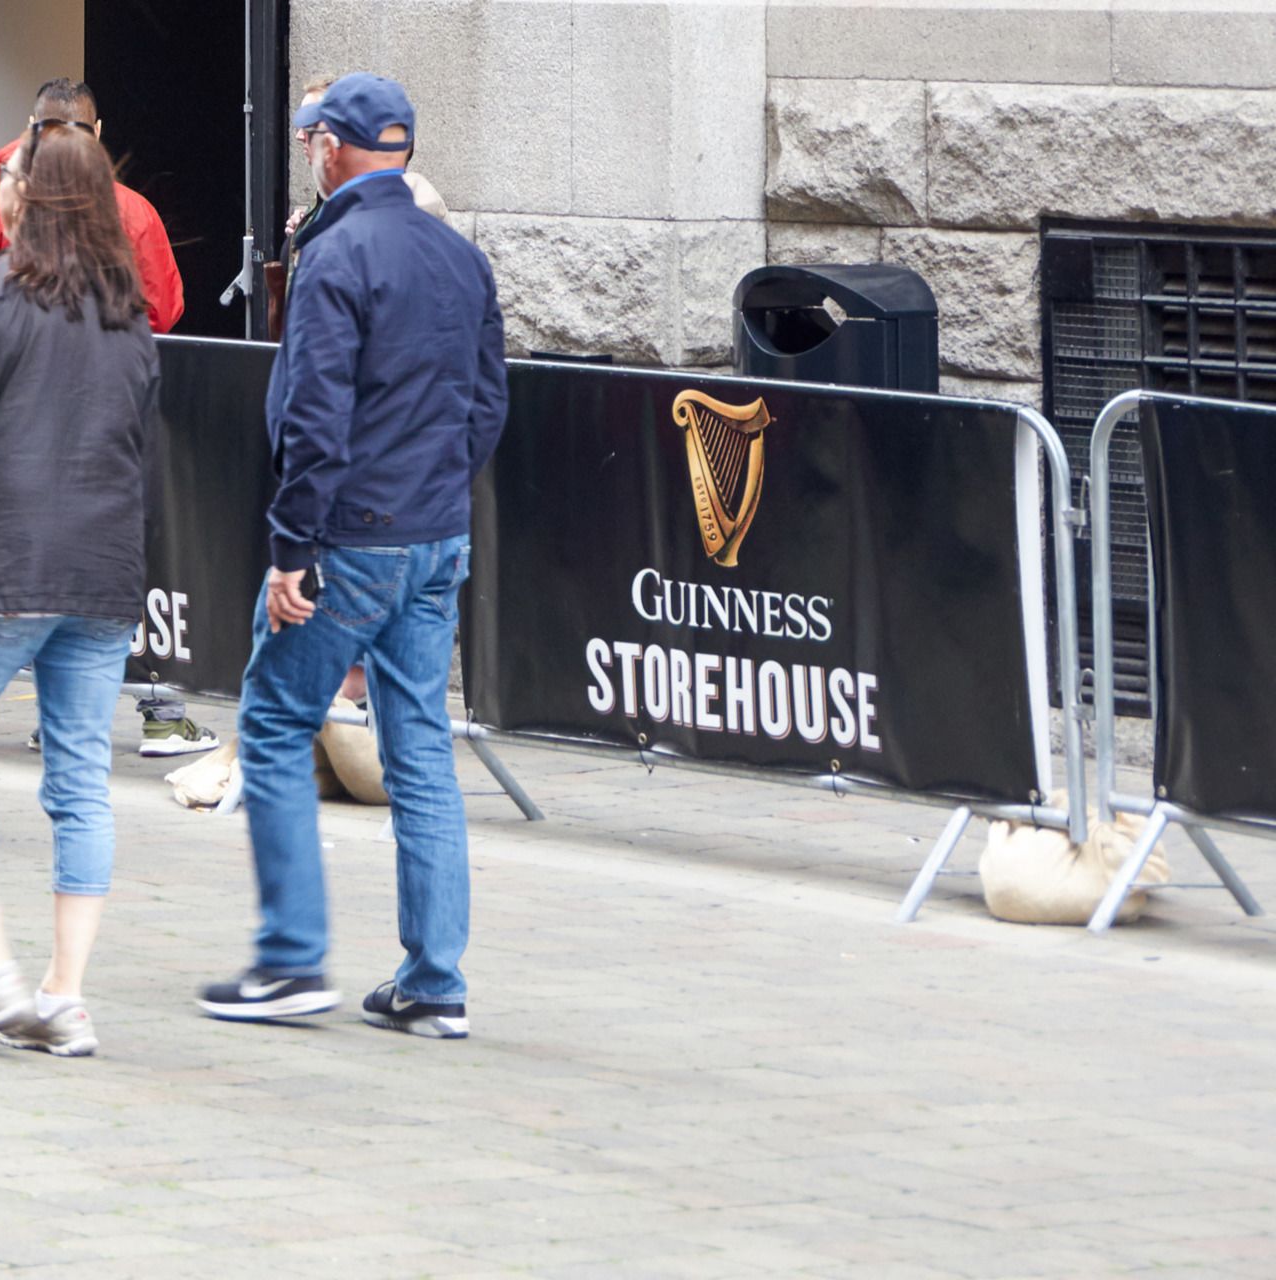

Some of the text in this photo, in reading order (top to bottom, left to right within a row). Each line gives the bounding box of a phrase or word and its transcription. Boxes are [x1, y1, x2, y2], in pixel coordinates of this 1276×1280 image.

[700, 507, 718, 541] 1759
[631, 568, 833, 641] GUINNESS
[586, 638, 882, 752] STOREHOUSE
